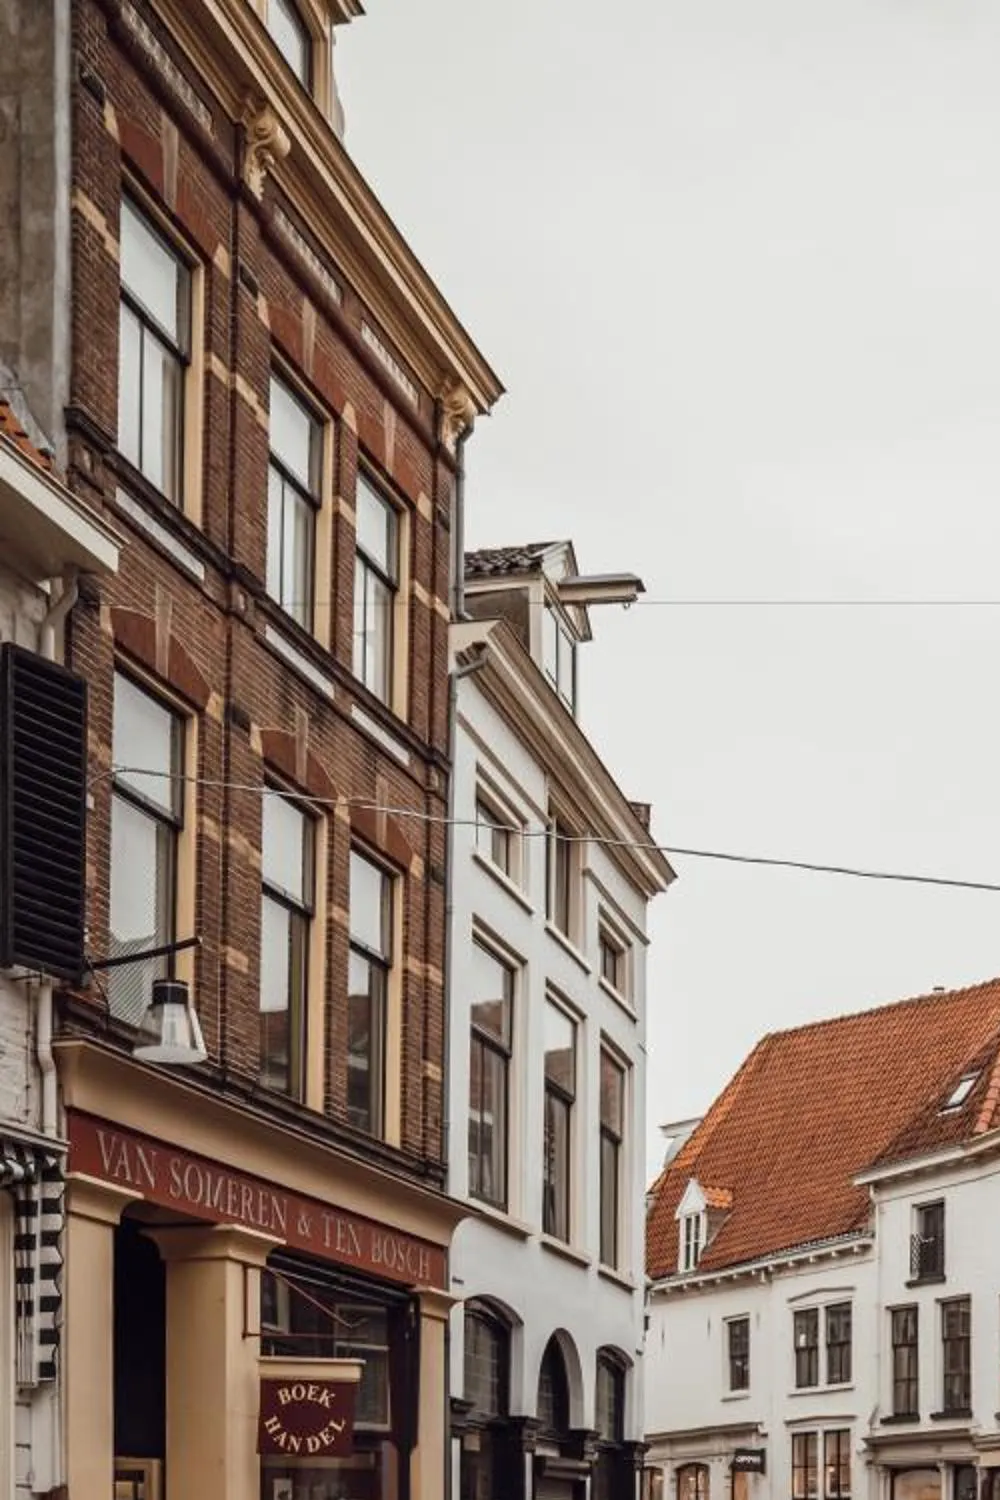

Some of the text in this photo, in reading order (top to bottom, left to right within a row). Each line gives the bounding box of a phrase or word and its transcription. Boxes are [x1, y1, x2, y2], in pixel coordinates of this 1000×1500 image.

[96, 1129, 431, 1281] VAN SOMEREN & TEN BOSCH
[277, 1383, 337, 1409] BOEK
[263, 1415, 347, 1453] HANDEL
